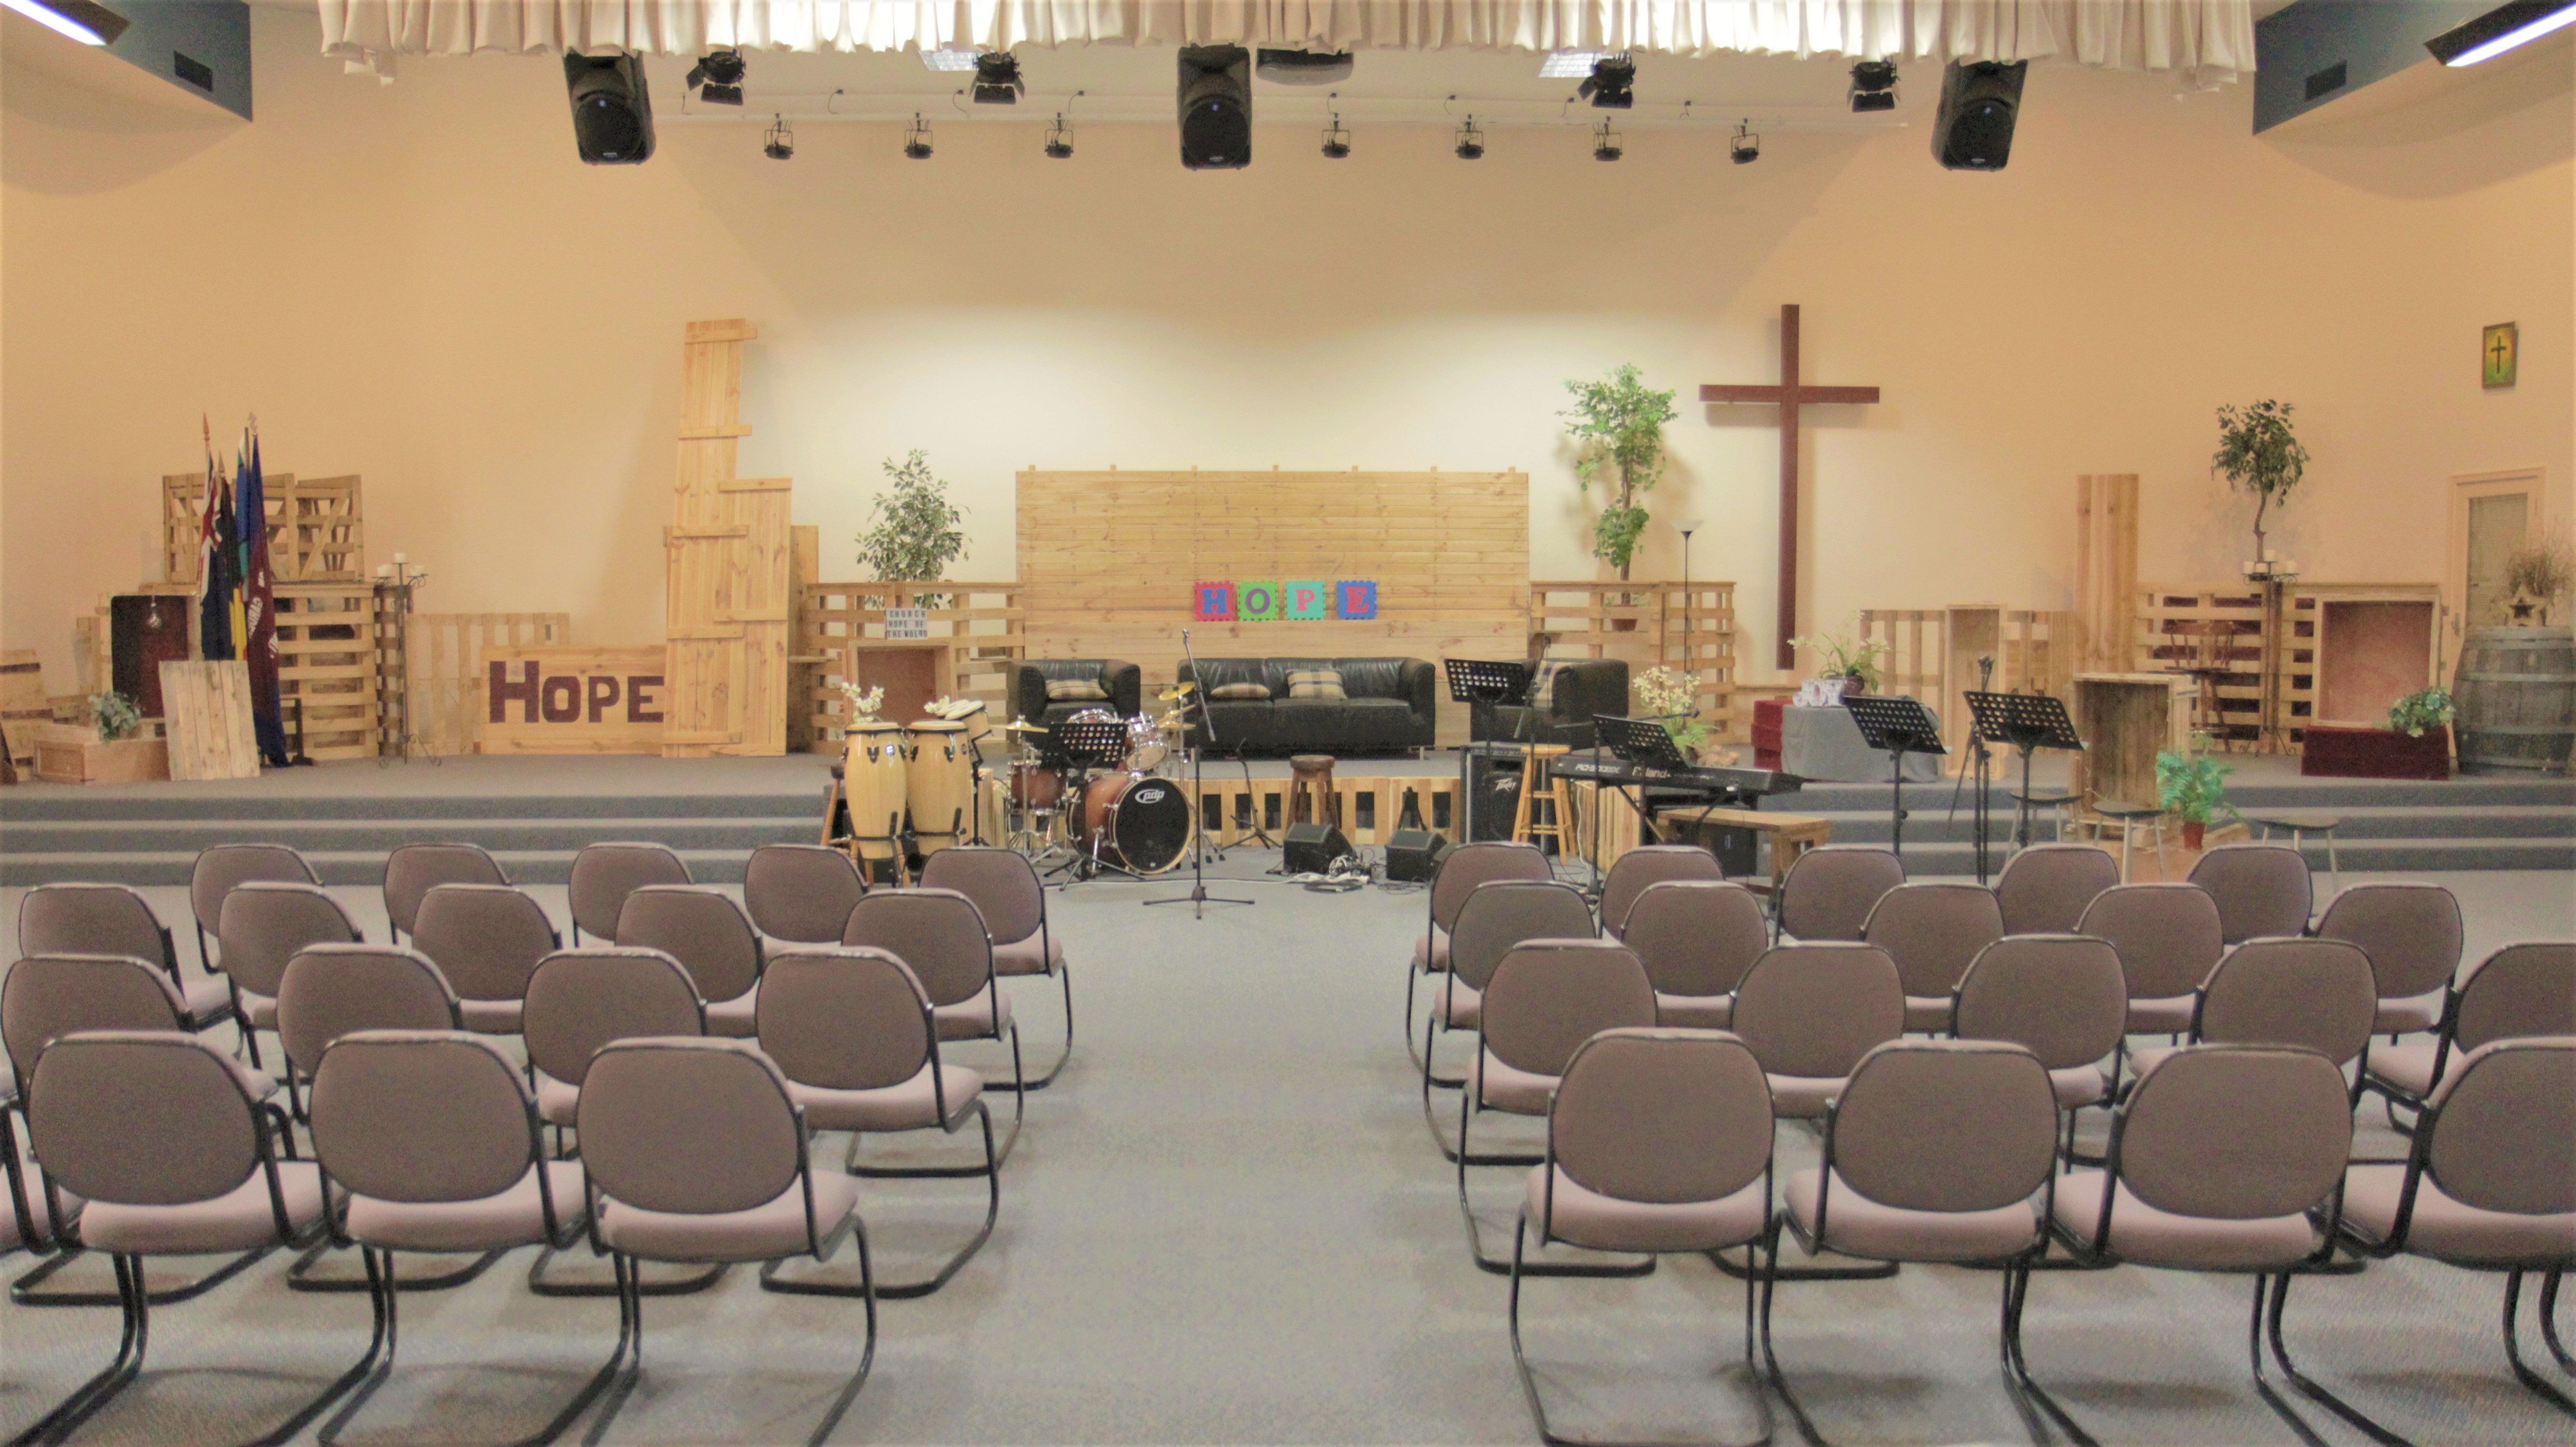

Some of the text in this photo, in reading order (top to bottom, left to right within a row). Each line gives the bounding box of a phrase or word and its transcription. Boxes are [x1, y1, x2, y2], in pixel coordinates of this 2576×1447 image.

[1202, 587, 1369, 614] HOPE
[489, 661, 665, 723] HOPE
[1632, 766, 1668, 779] Rland
[1142, 789, 1165, 802] pdp
